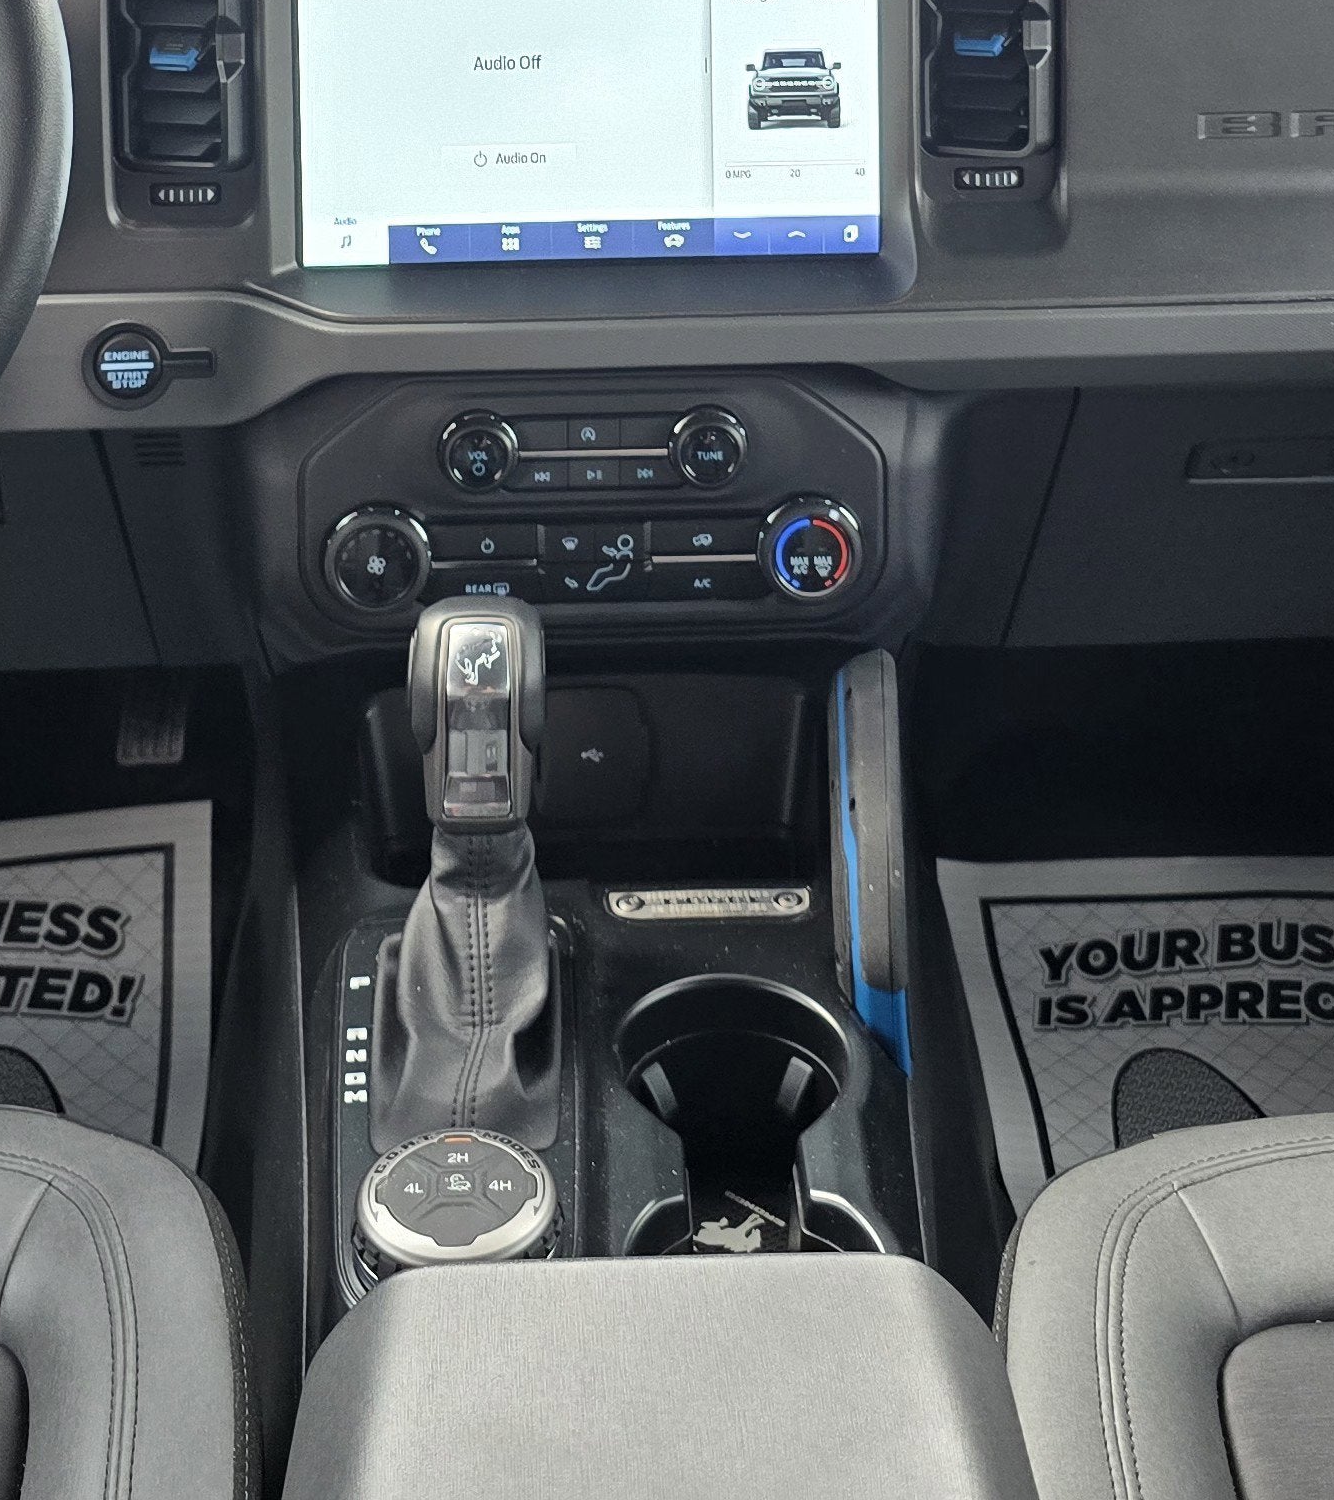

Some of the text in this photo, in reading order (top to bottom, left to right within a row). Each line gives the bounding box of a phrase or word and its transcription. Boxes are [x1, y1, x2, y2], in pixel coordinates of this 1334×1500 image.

[473, 54, 542, 71] Audio Off
[495, 151, 547, 164] Audio On
[333, 217, 357, 226] Audio
[657, 220, 691, 232] Features
[416, 227, 441, 237] Phone
[577, 222, 609, 234] Settings
[103, 350, 150, 362] ENGINE
[107, 370, 150, 381] START
[112, 379, 147, 390] STOP
[468, 451, 488, 461] VOL
[697, 450, 724, 461] TUNE
[465, 583, 491, 594] REAR
[693, 578, 711, 588] A/C
[1038, 927, 1205, 984] YOUR
[1035, 994, 1093, 1030] IS
[346, 1049, 367, 1062] N
[344, 1089, 368, 1103] M
[482, 1130, 542, 1170] MODES
[447, 1152, 469, 1164] 2H
[403, 1182, 425, 1195] 4L
[488, 1179, 513, 1192] 4H
